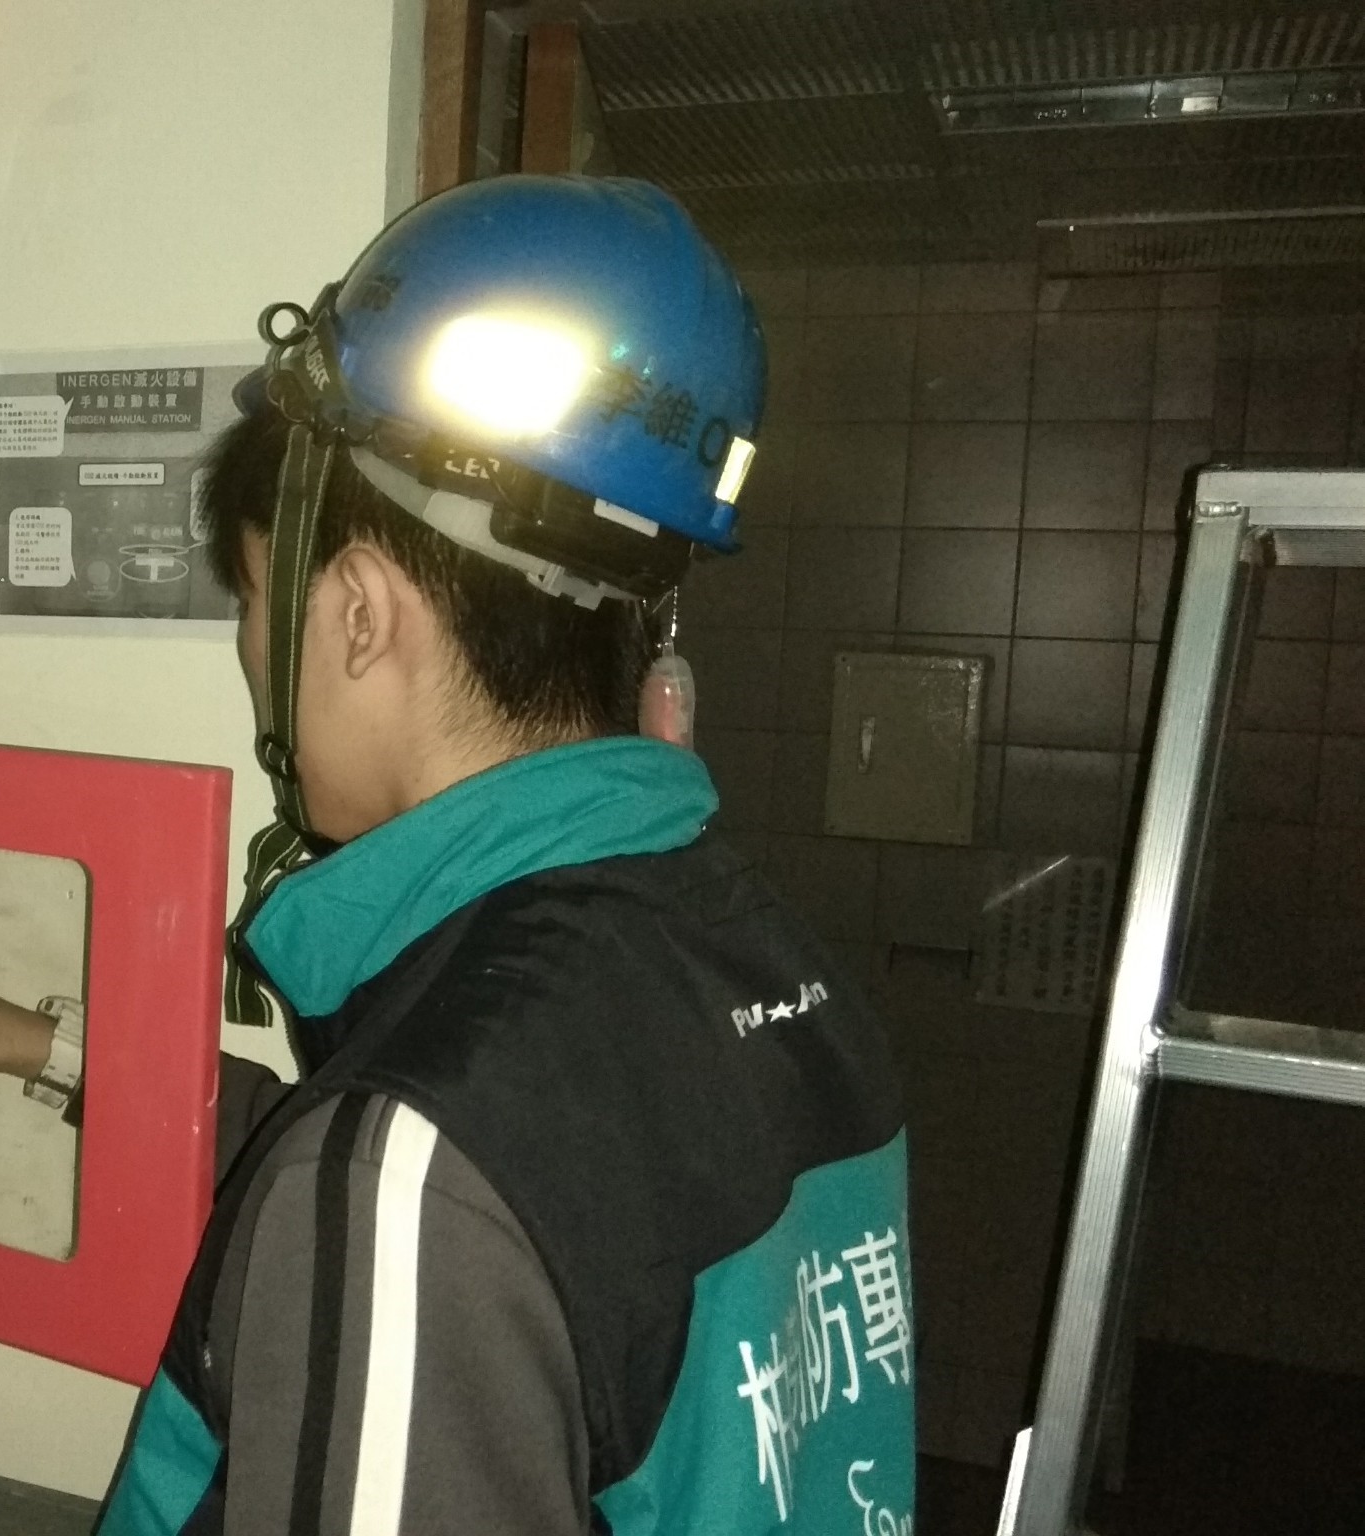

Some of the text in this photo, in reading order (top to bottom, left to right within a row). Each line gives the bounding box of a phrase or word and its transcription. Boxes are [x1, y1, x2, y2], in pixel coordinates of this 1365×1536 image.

[65, 413, 192, 425] INERGEN MANUAL STATION
